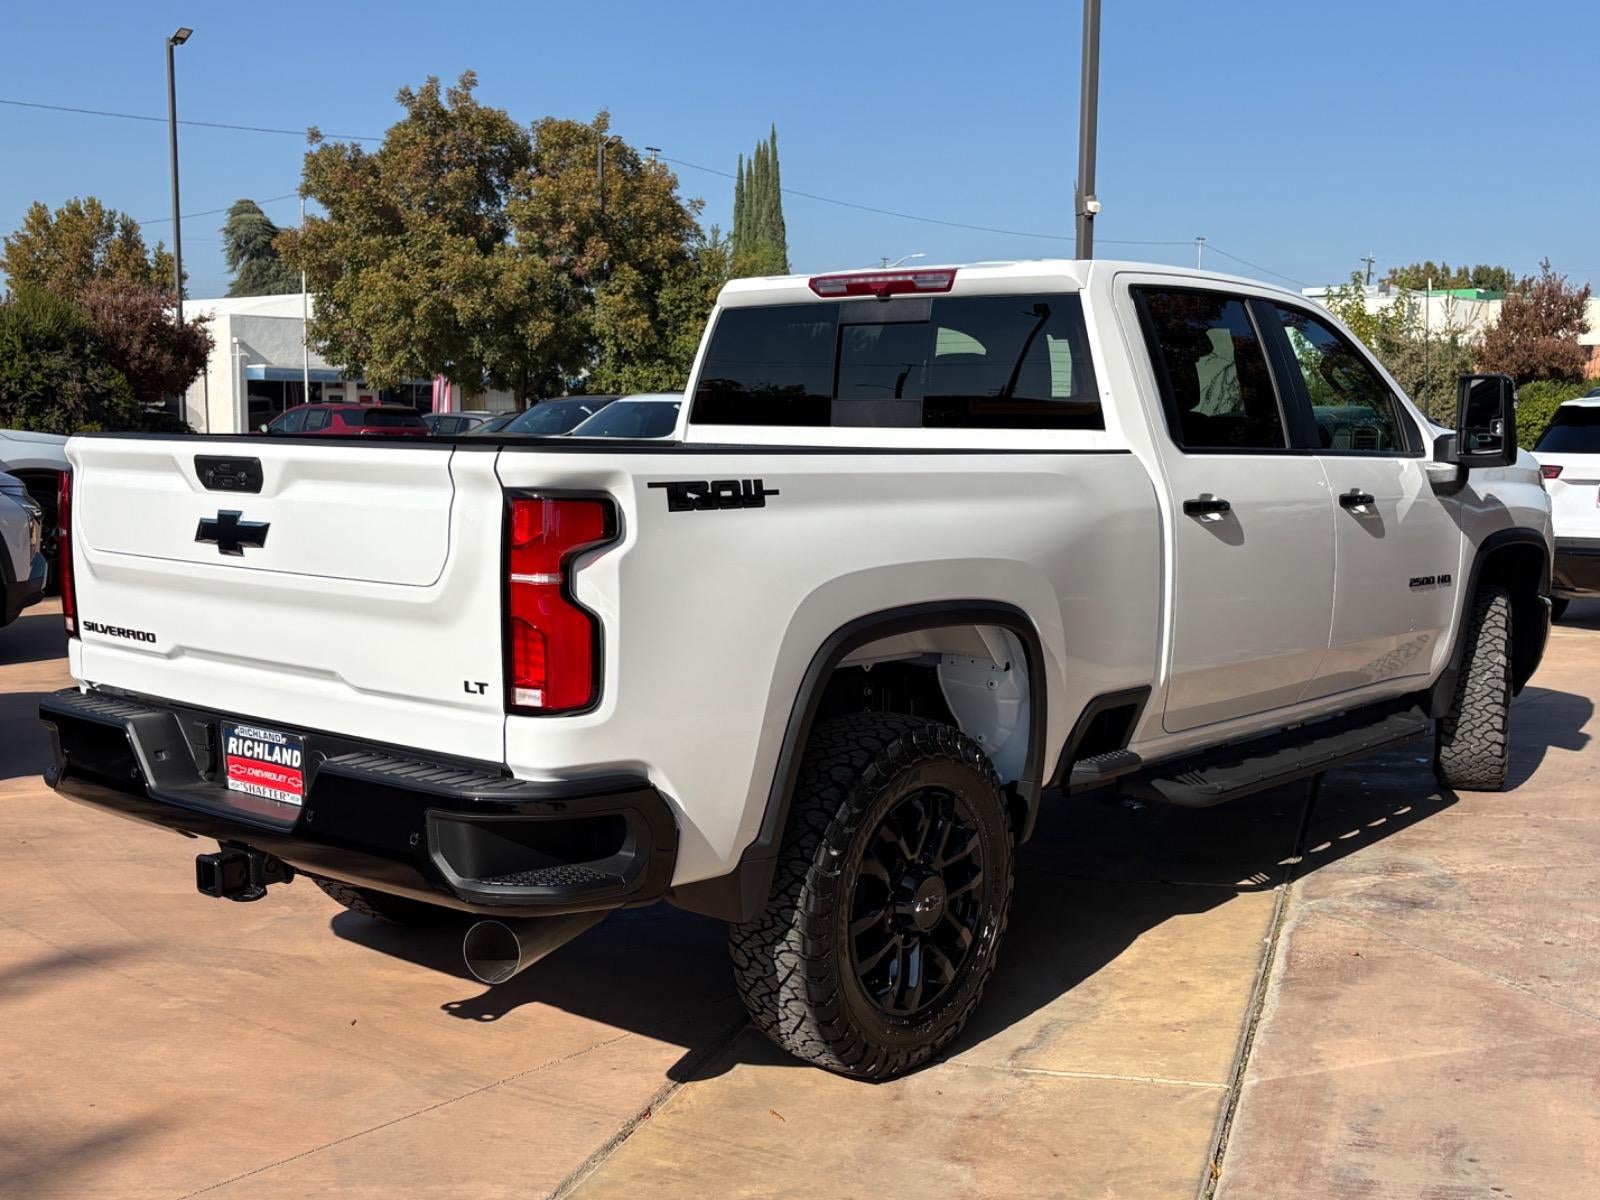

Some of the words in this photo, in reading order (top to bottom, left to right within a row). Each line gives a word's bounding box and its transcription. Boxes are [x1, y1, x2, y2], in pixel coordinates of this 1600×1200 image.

[1409, 575, 1435, 587] 2500
[82, 620, 157, 643] SILVERADO
[463, 680, 489, 695] LT
[239, 727, 282, 742] RICHLAND
[227, 736, 302, 768] RICHLAND
[247, 767, 287, 783] CHEVROLET
